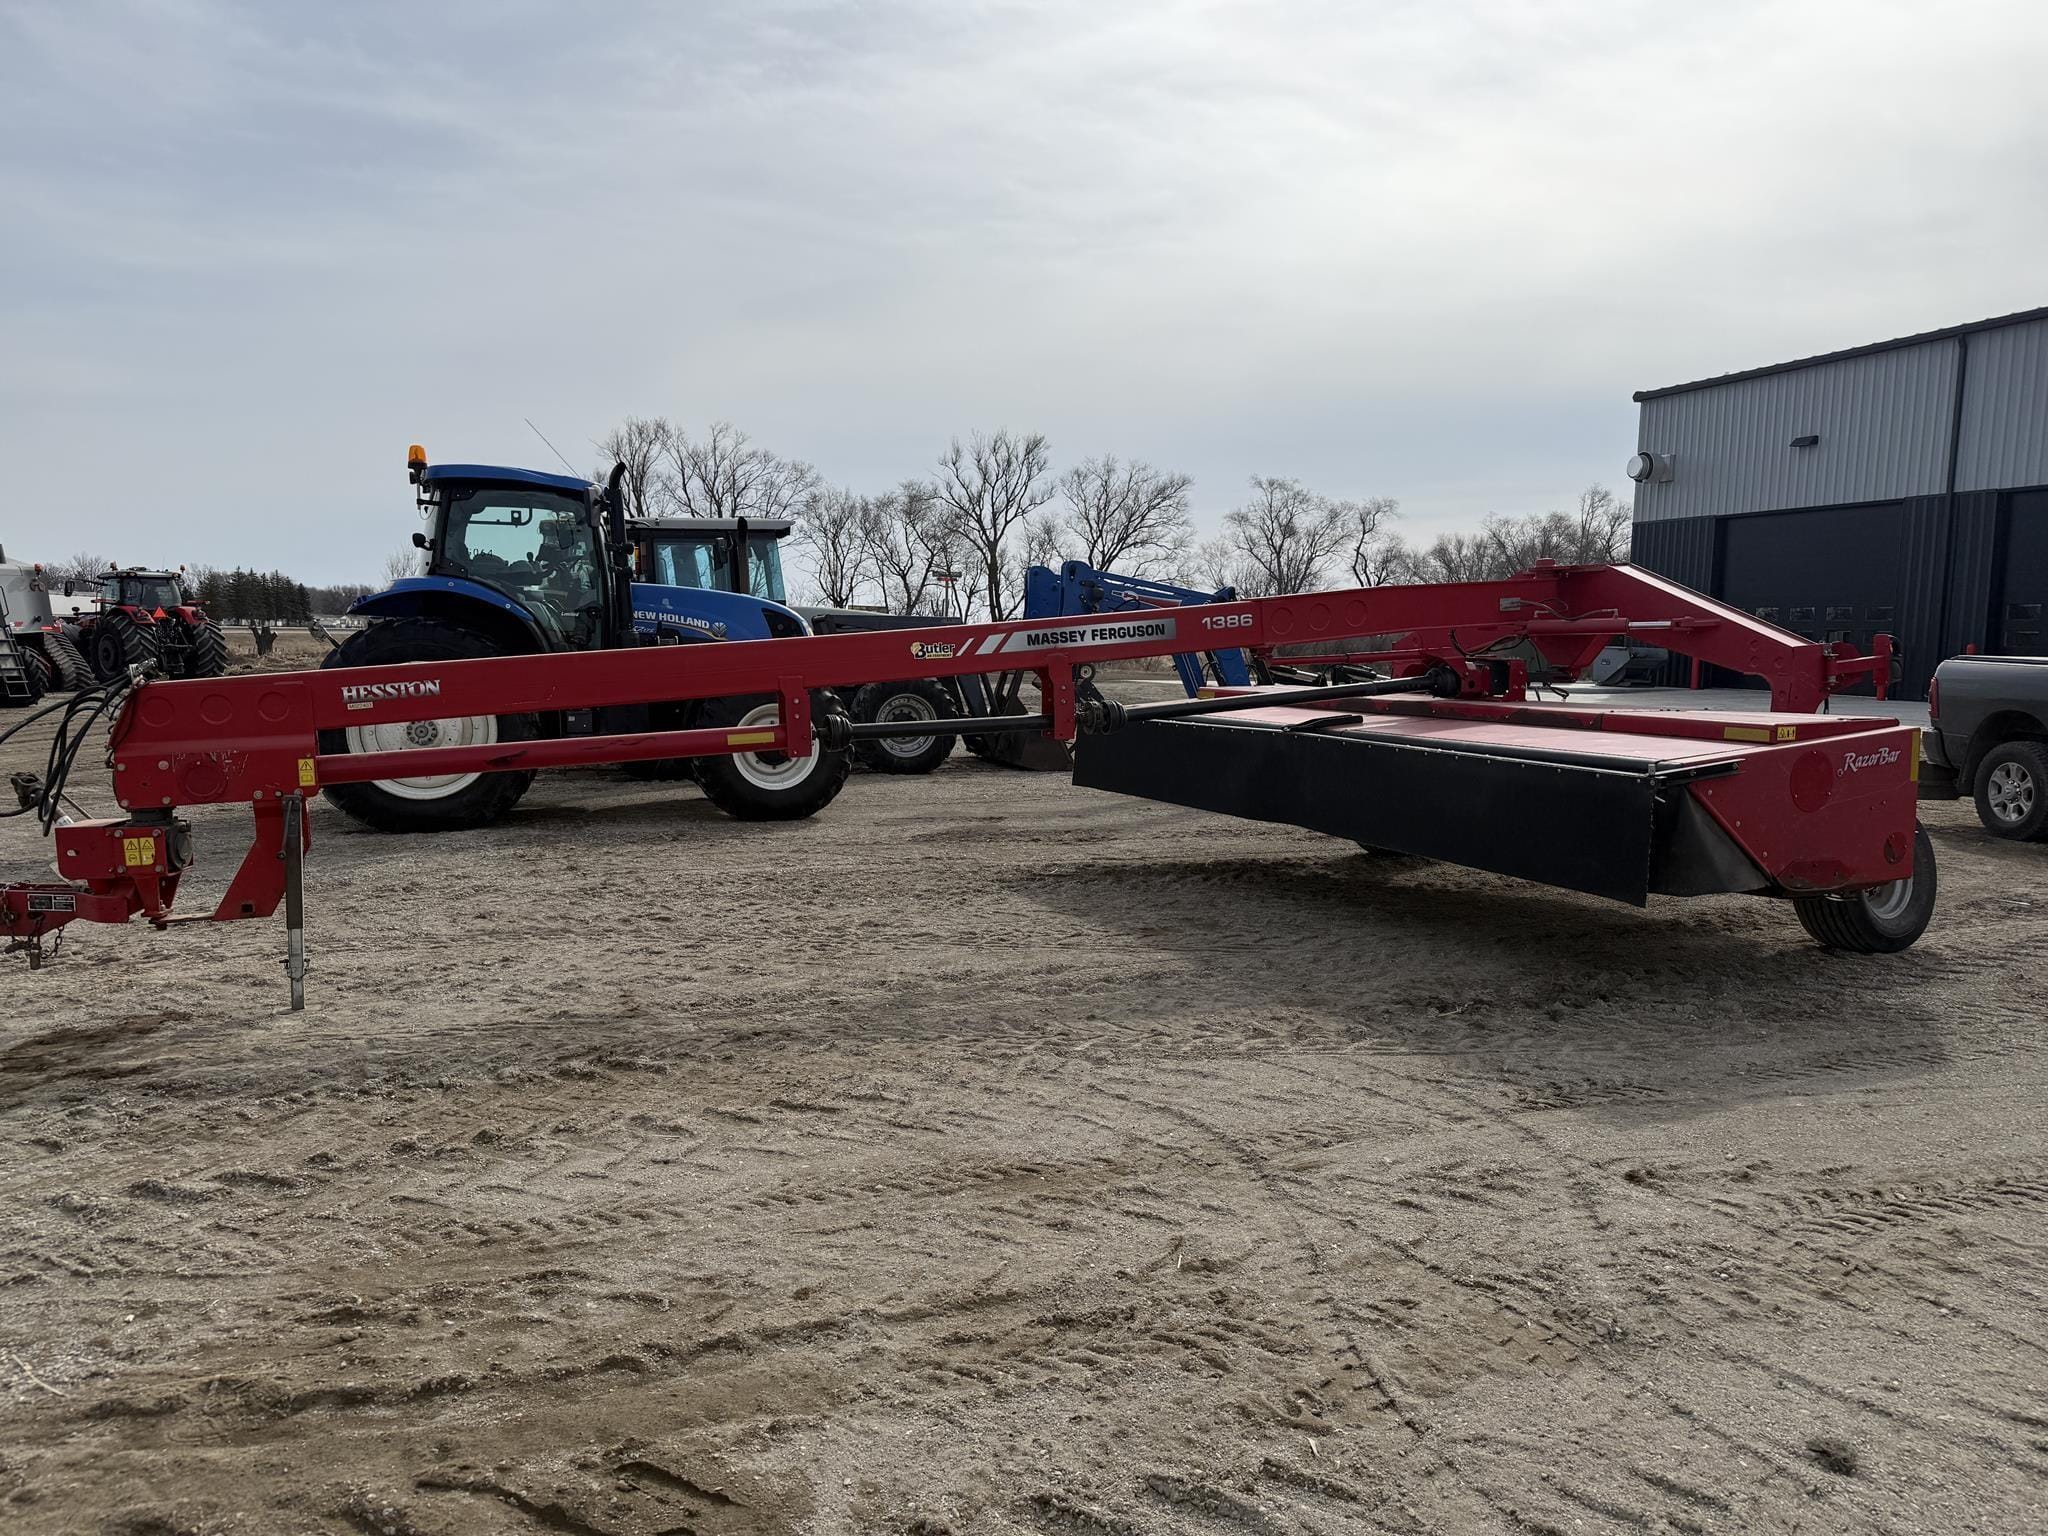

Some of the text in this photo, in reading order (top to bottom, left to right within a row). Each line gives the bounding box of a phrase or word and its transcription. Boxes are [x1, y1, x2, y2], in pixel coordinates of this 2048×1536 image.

[633, 610, 656, 620] NEW
[659, 612, 709, 629] HOLLAND
[1201, 613, 1253, 630] 1386
[1027, 623, 1165, 646] MASSEY FERGUSON
[914, 643, 954, 658] Butler
[341, 679, 441, 702] HESSTON
[1843, 747, 1901, 772] RazorBar
